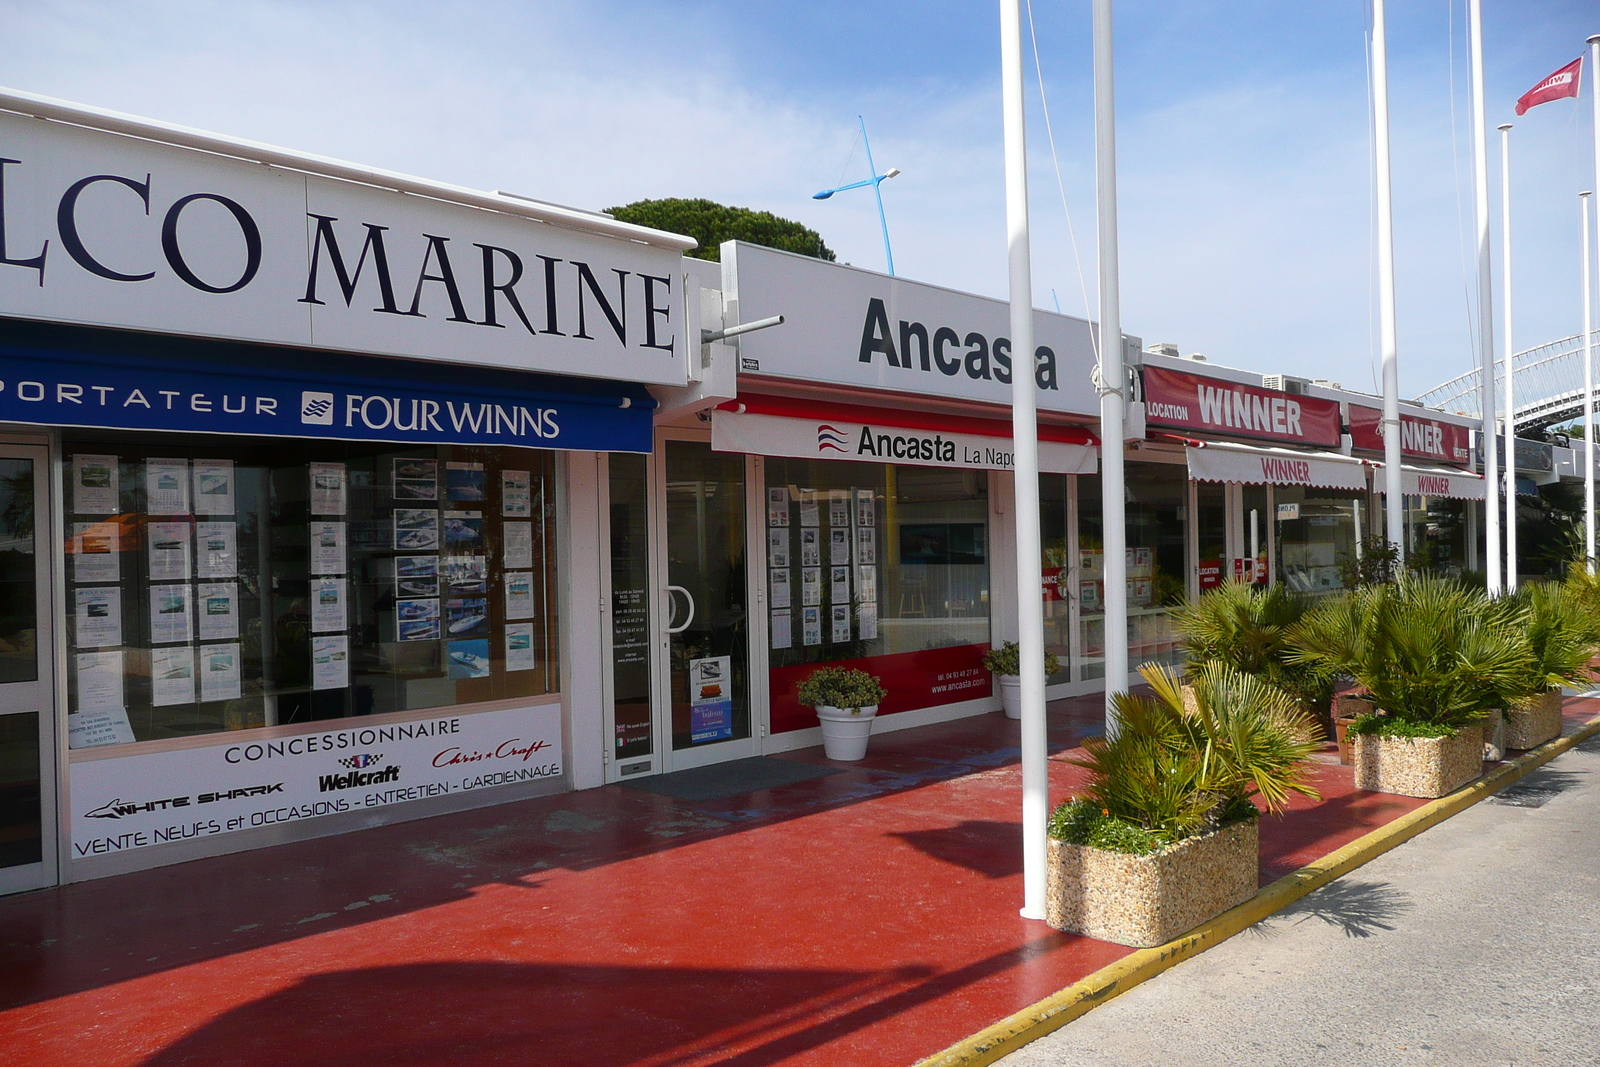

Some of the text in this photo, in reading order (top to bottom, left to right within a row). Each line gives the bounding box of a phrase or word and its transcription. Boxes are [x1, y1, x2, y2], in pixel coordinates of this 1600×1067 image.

[298, 213, 674, 358] MARINE
[859, 297, 1059, 391] Ancasa
[0, 381, 278, 416] ORTATEUR
[1148, 401, 1189, 421] LOCATION
[1197, 384, 1303, 436] WINNER
[345, 394, 560, 439] FOUR WINNS
[857, 426, 956, 462] Ancasta
[964, 446, 981, 464] La
[1386, 420, 1443, 455] NNER
[1261, 457, 1311, 482] WINNER
[1418, 475, 1450, 494] WINNER
[932, 679, 986, 693] www.ancasta.com
[225, 719, 460, 764] CONCESSIONNAIRE
[432, 738, 552, 768] Chris Craft
[318, 765, 402, 792] Wellcraft
[75, 831, 148, 856] VENTE
[154, 820, 220, 843] NEUFS
[227, 815, 245, 830] et
[251, 798, 350, 826] OCCASIONS
[365, 782, 449, 807] ENTRETIEN
[463, 763, 560, 790] GARDIENNAGE
[112, 782, 285, 816] WHITE SHARK
